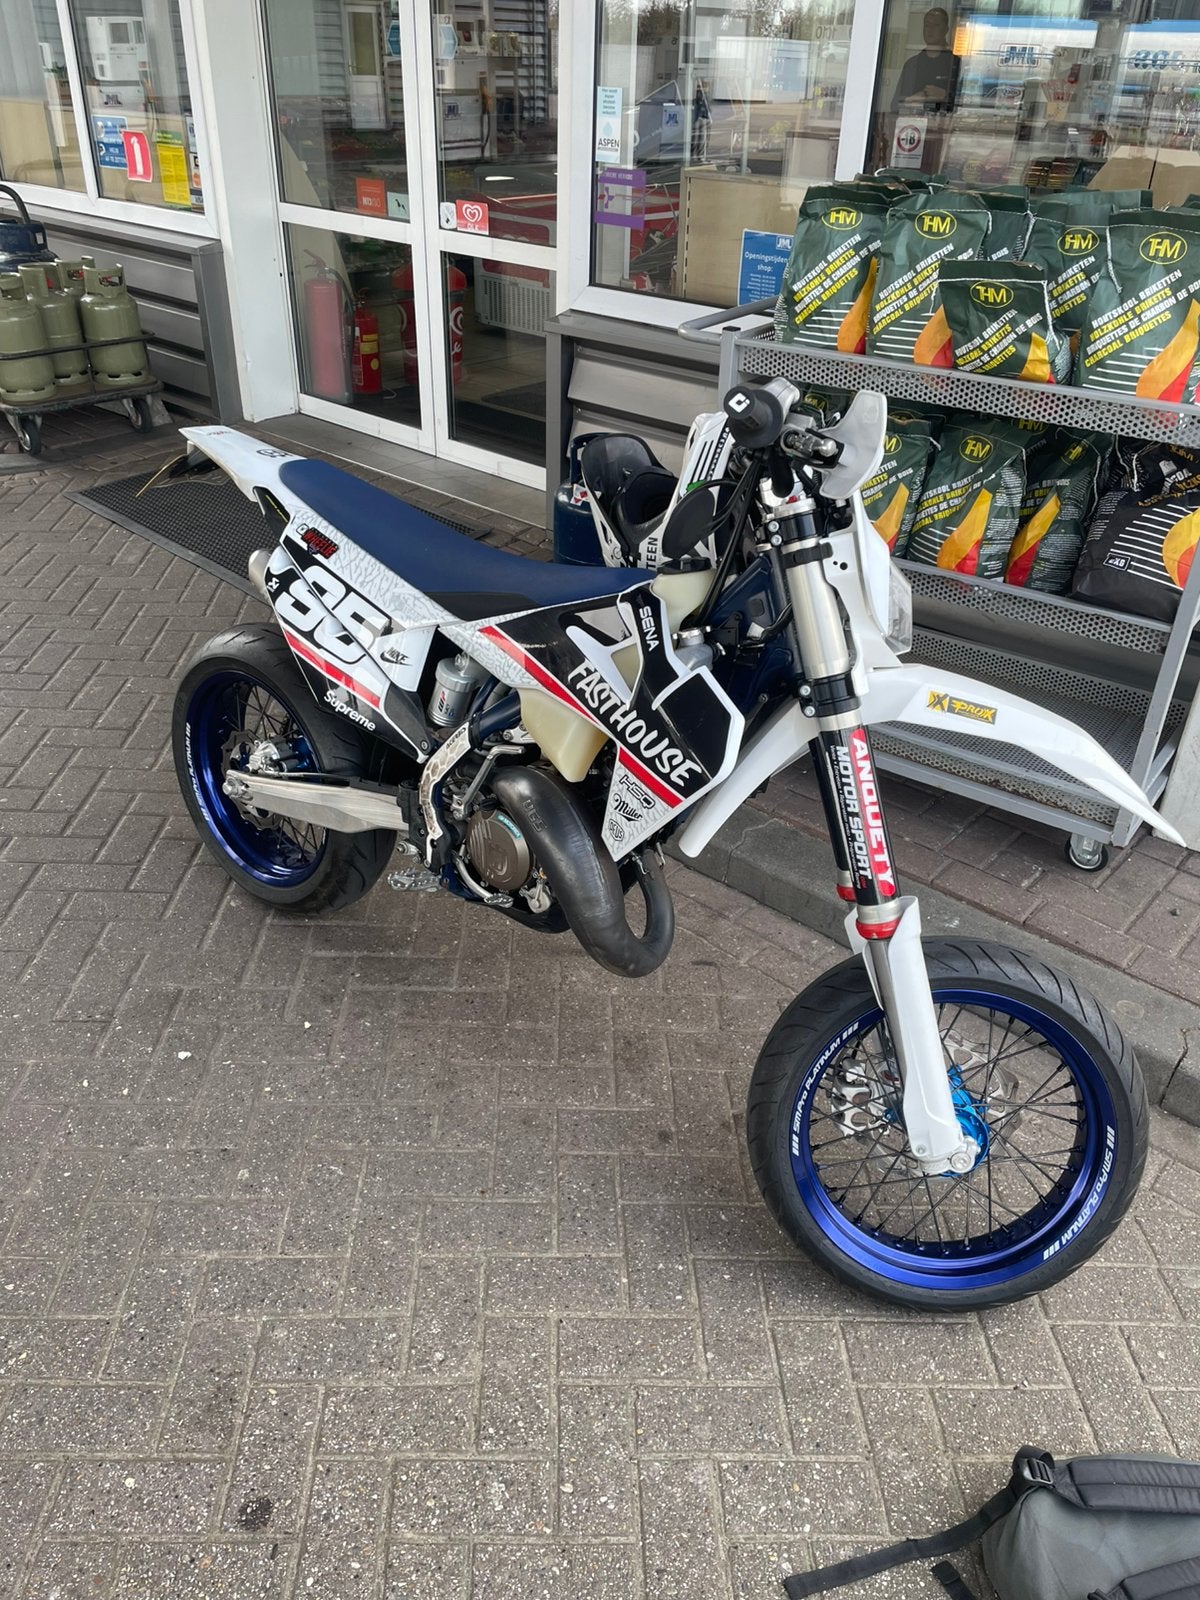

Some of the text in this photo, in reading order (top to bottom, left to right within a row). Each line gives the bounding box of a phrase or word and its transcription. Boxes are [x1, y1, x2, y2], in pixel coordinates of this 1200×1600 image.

[598, 138, 620, 148] ASPEN
[922, 215, 951, 233] THM
[792, 260, 828, 292] HOUTSKOOL
[827, 233, 862, 262] BRIKETTEN
[825, 248, 856, 277] BRIKETTS
[991, 247, 1010, 261] BOIS
[1148, 238, 1182, 259] THM
[824, 277, 833, 289] DE
[831, 256, 861, 281] CHARBON
[859, 246, 869, 259] DE
[878, 242, 955, 300] HOUTSKOOL BRIKETTEN
[1057, 255, 1096, 282] BRIKETTEN
[821, 267, 859, 302] BRIQUETTES
[875, 282, 913, 312] HOLZKOHLE
[908, 290, 919, 299] DE
[976, 285, 1007, 303] THM
[1052, 271, 1087, 297] BRIKETTS
[1058, 280, 1091, 305] CHARBON
[1091, 269, 1183, 329] HOUTSKOOL BRIKETTEN
[872, 310, 904, 335] CHARCOAL
[1015, 323, 1027, 336] DE
[1025, 312, 1043, 327] BOIS
[1086, 326, 1128, 355] BRIQUETTES
[1129, 316, 1141, 329] DE
[1140, 294, 1177, 322] CHARBON
[1176, 286, 1189, 301] DE
[1089, 287, 1172, 342] HOLZKOHLE BRIKETTS
[981, 323, 1012, 352] BRIKETTS
[1084, 310, 1172, 368] CHARCOAL BRIQUETTES
[965, 439, 991, 458] THM
[939, 500, 948, 510] DE
[639, 606, 660, 652] SENA
[324, 689, 376, 732] Supreme
[567, 656, 703, 787] FASTHOUSE
[613, 792, 643, 819] Miller
[619, 774, 656, 809] HSQ
[836, 745, 860, 813] MOTOR
[849, 816, 873, 880] SPORT
[853, 737, 895, 888] ANQUETY
[609, 821, 624, 839] DEUS
[805, 1037, 841, 1090] PLATINUM
[1061, 1190, 1099, 1246] PLATINUM
